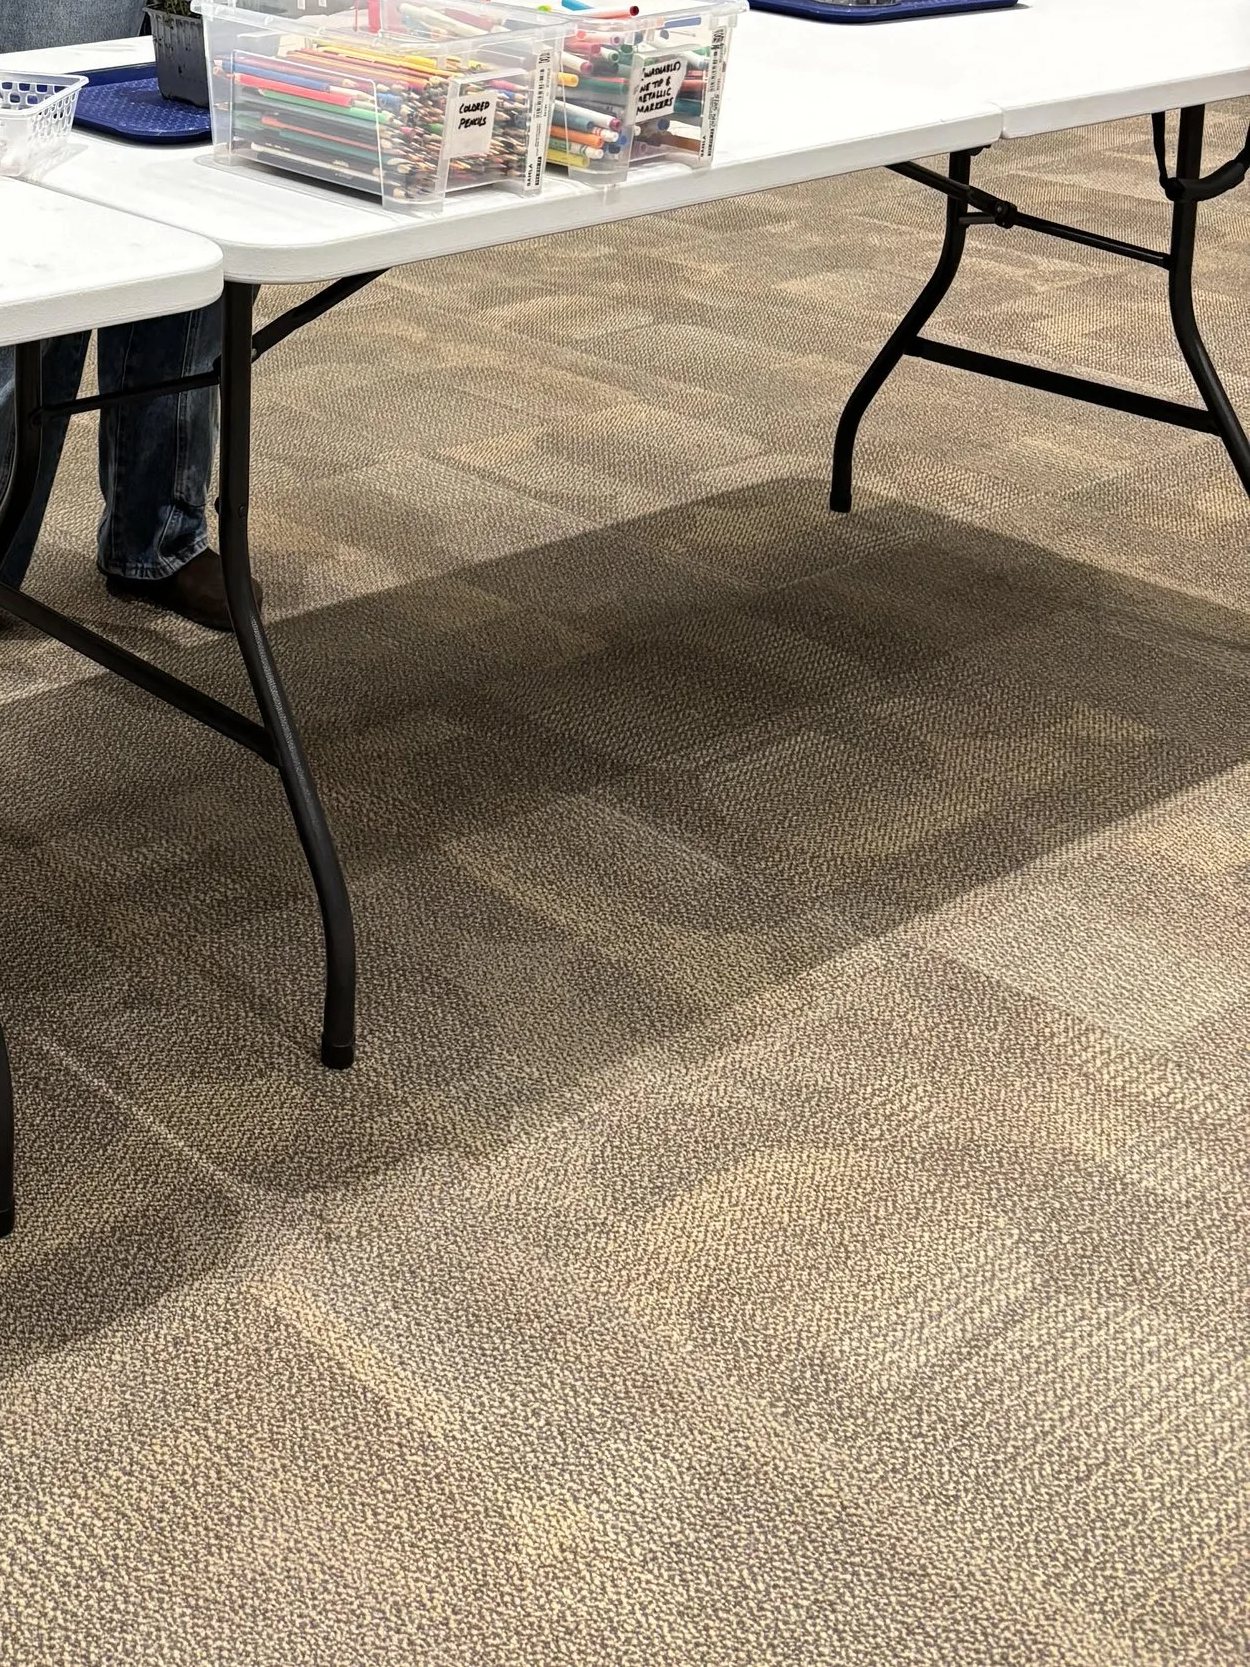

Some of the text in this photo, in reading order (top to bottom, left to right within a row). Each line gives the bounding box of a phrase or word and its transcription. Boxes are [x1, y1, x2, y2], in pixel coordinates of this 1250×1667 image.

[459, 101, 490, 114] COLORED
[636, 97, 674, 116] MARKERS
[458, 116, 487, 130] PENCILS
